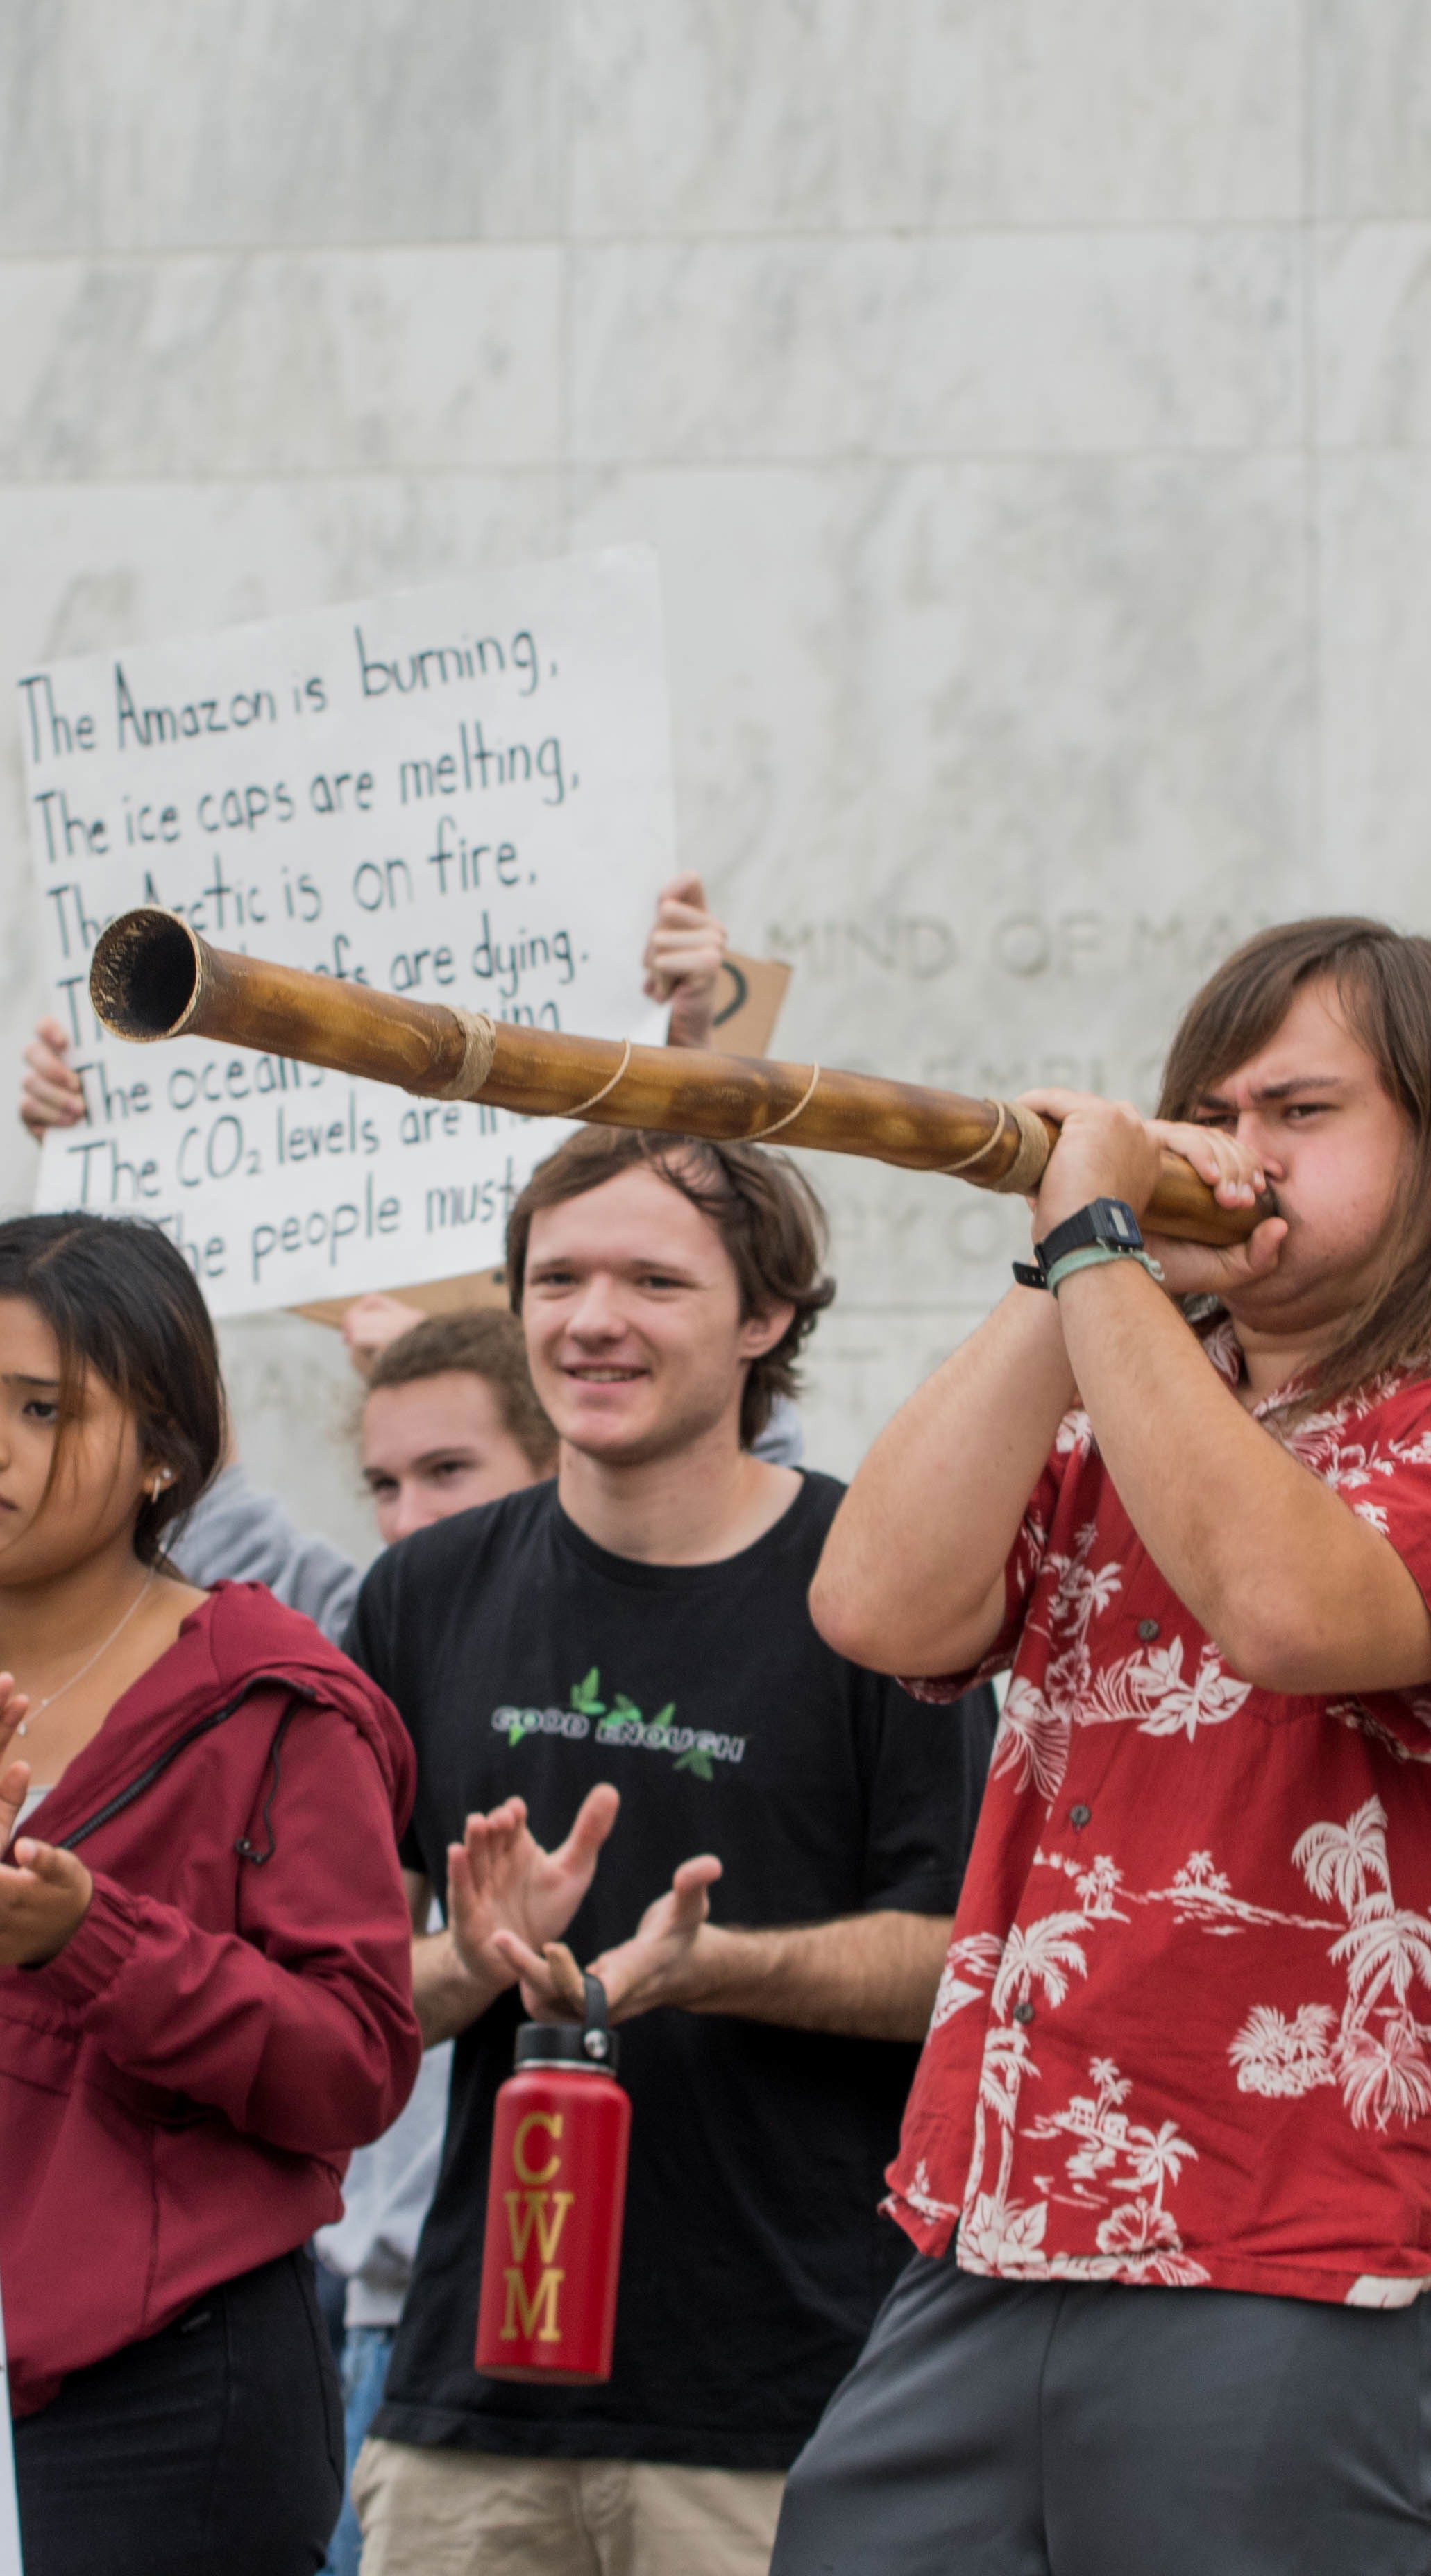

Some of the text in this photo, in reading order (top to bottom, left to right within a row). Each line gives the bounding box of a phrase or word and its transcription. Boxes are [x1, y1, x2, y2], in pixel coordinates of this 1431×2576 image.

[17, 625, 558, 763] The Amazon is burning,
[33, 720, 579, 863] The ice caps are melting,
[281, 866, 322, 922] is
[353, 857, 414, 912] on
[390, 948, 455, 991] are
[989, 906, 1105, 977] OF
[73, 1061, 151, 1126] The
[67, 1140, 160, 1204] The
[276, 1088, 380, 1164] levels
[400, 1105, 459, 1144] are
[251, 1171, 401, 1282] people
[426, 1154, 516, 1235] must
[491, 1704, 746, 1764] GOOD ENOUGH
